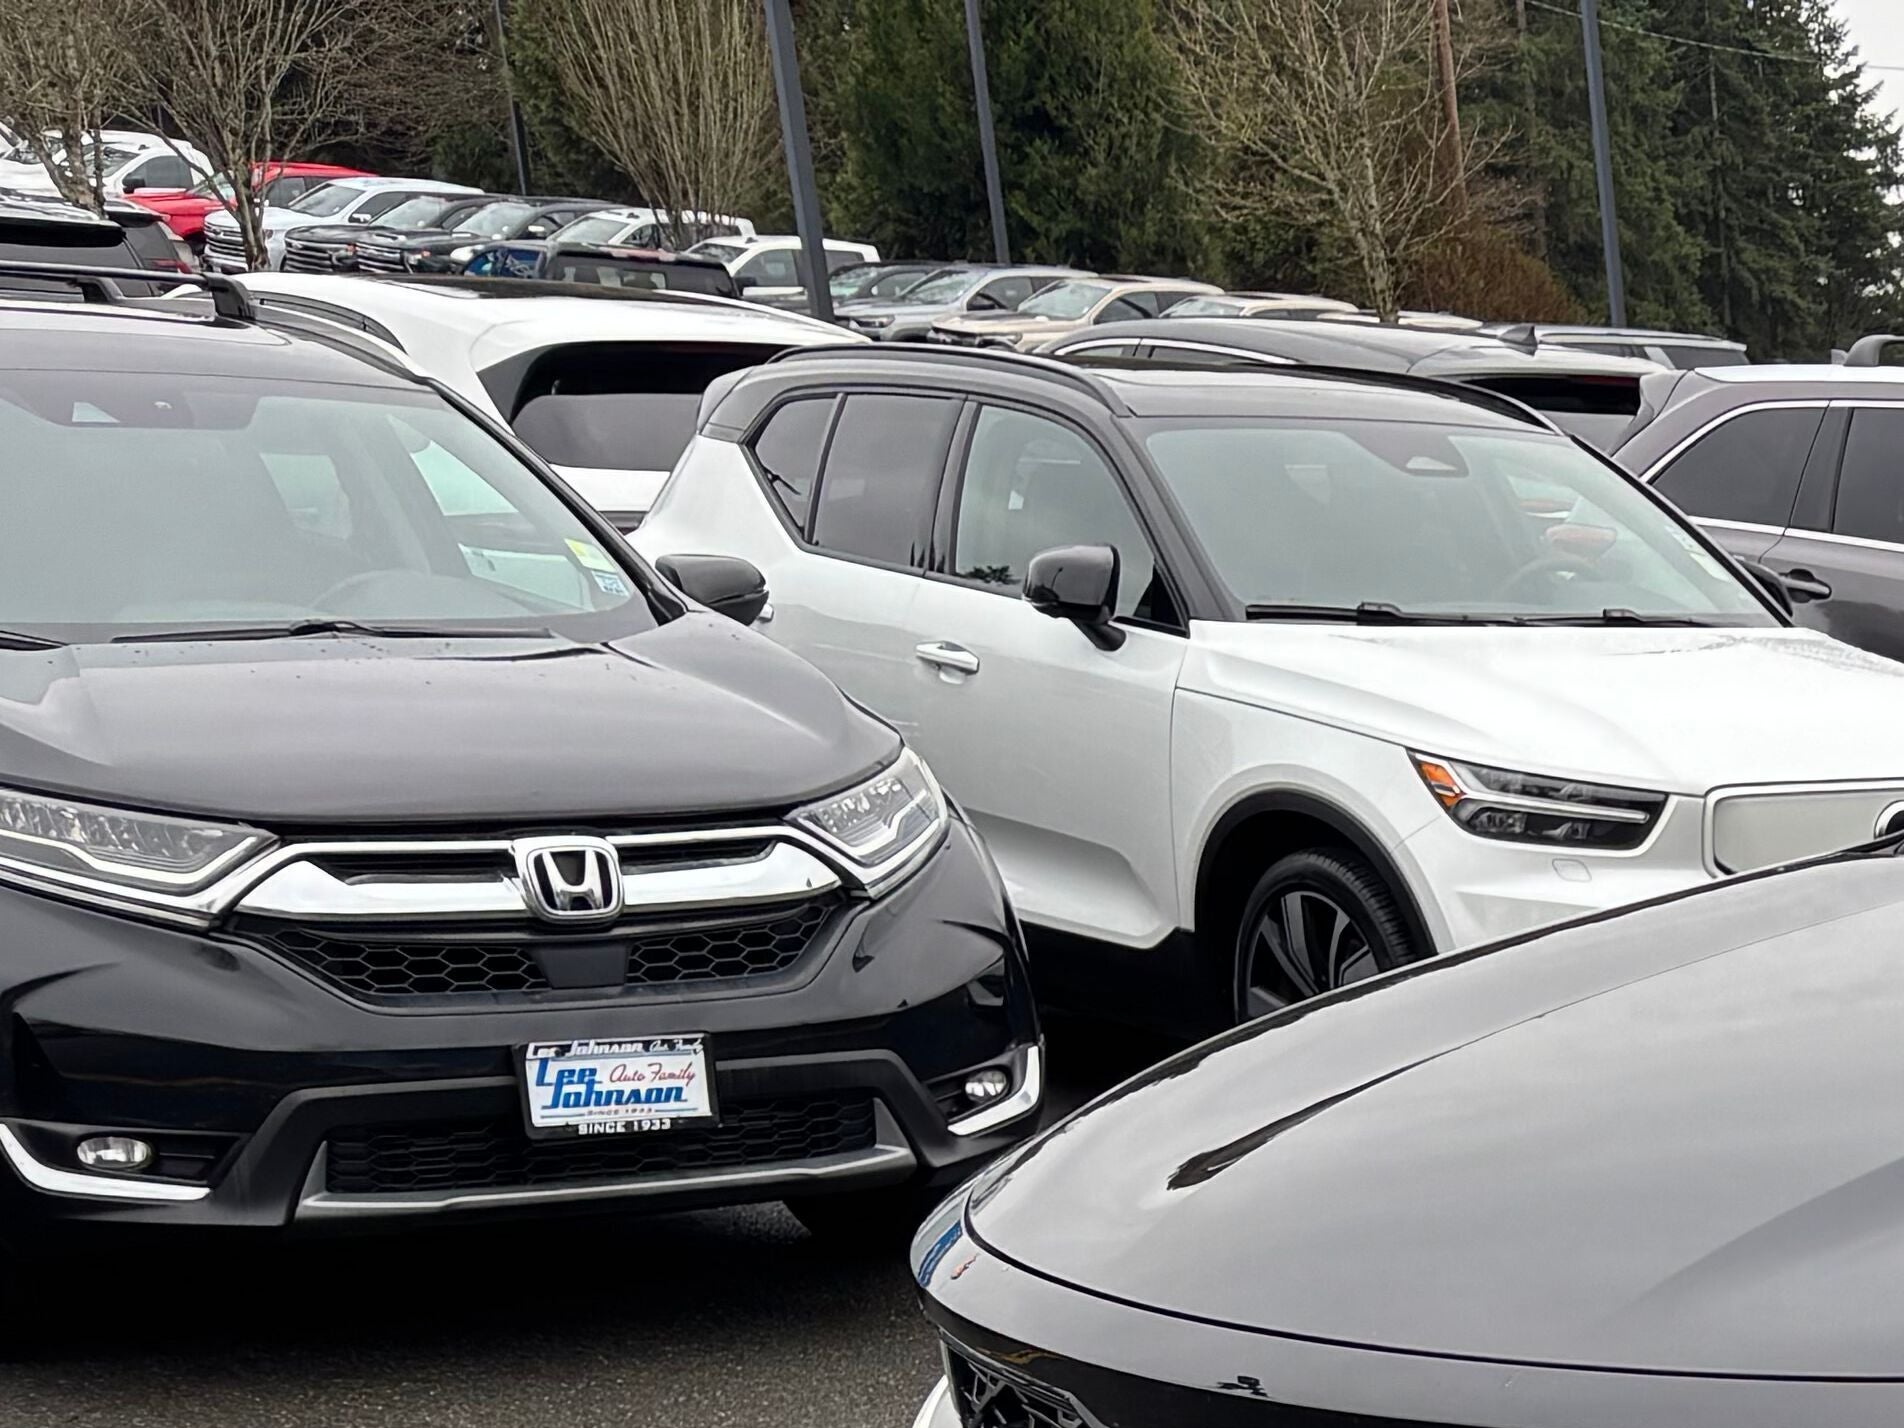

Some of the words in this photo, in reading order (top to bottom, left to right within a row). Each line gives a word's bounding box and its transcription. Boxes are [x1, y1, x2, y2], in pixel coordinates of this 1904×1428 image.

[536, 1058, 603, 1087] Lee
[609, 1063, 647, 1083] Auto
[647, 1062, 697, 1087] Family
[541, 1077, 688, 1110] Johnson
[578, 1121, 626, 1135] SINCE
[633, 1118, 672, 1131] 1933
